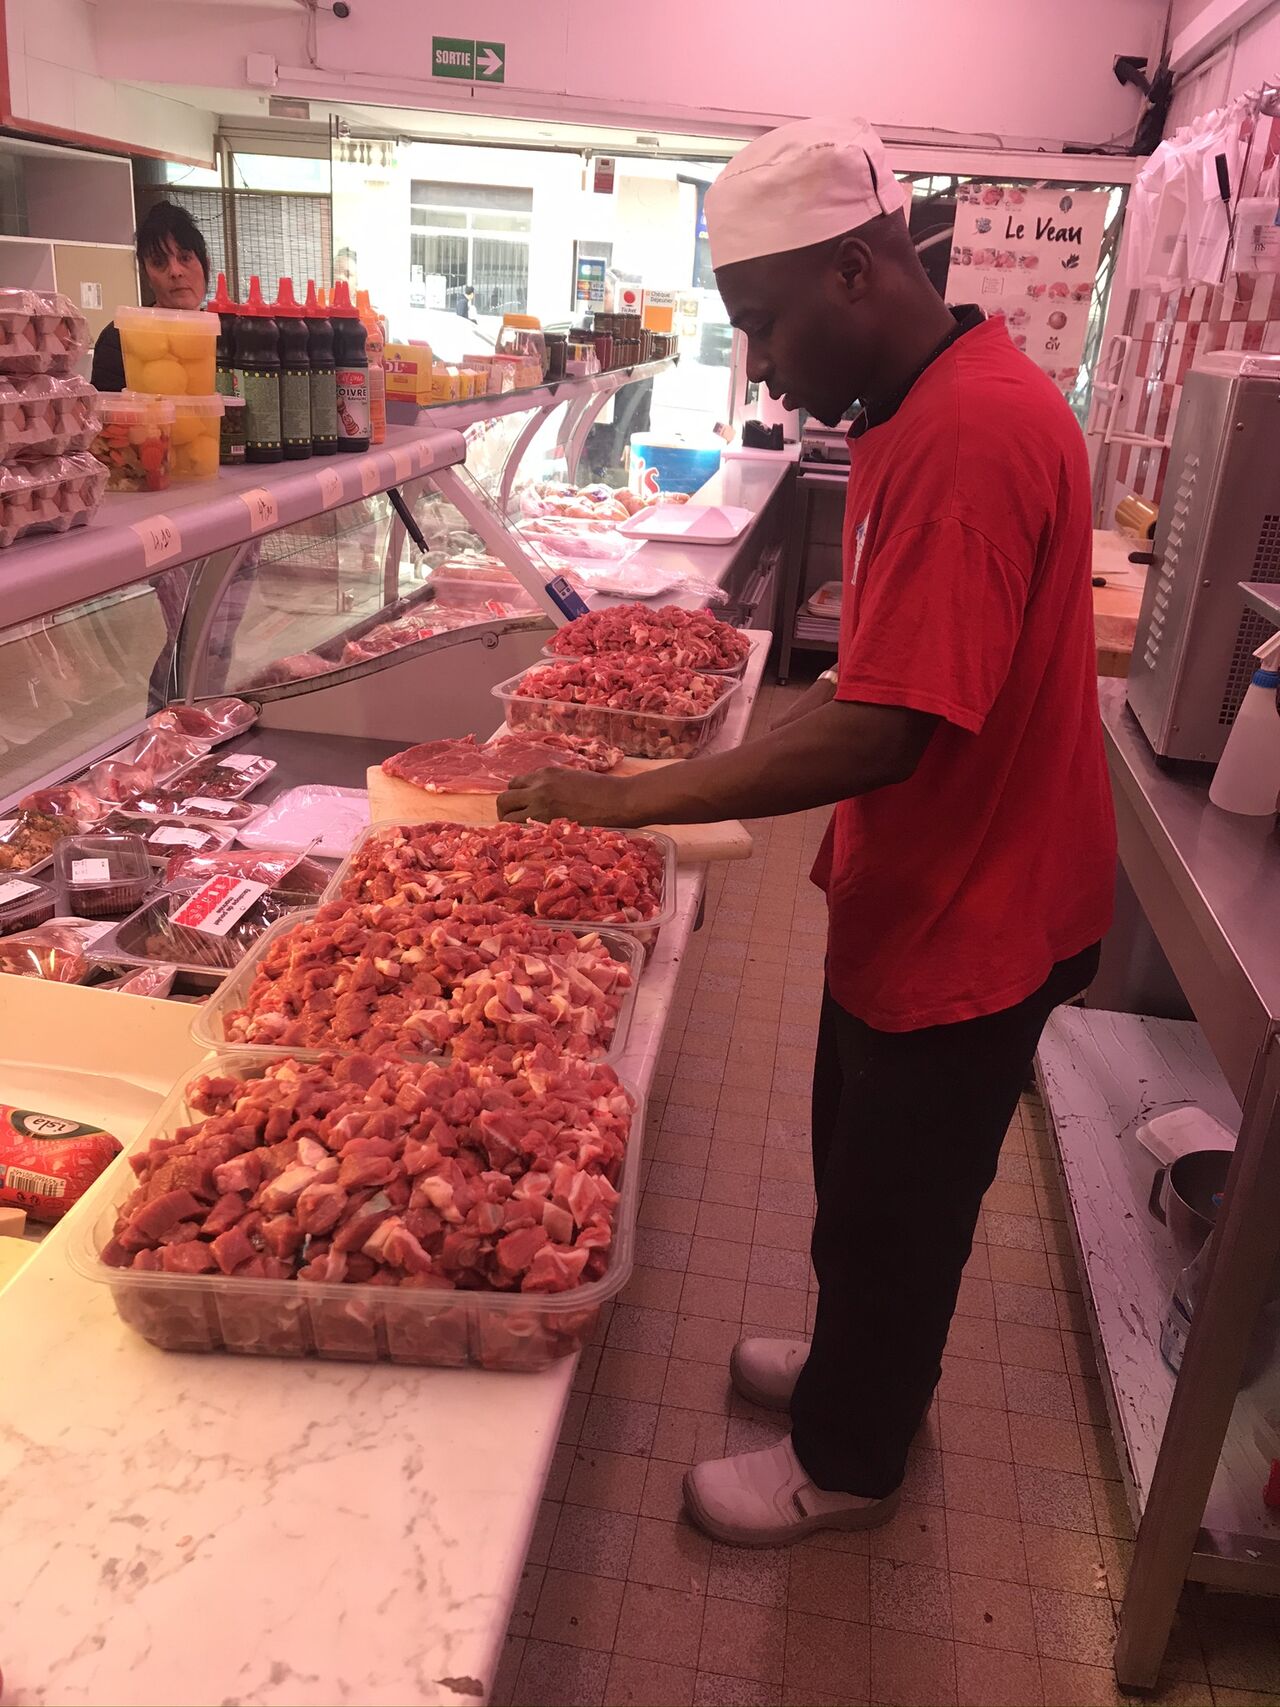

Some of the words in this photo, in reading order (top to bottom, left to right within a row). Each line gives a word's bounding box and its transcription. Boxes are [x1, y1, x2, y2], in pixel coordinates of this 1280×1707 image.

[436, 49, 471, 66] SORTIE
[1005, 215, 1025, 240] Le
[1035, 217, 1082, 244] Veau
[337, 388, 367, 397] OIVRE
[32, 1118, 66, 1132] isla
